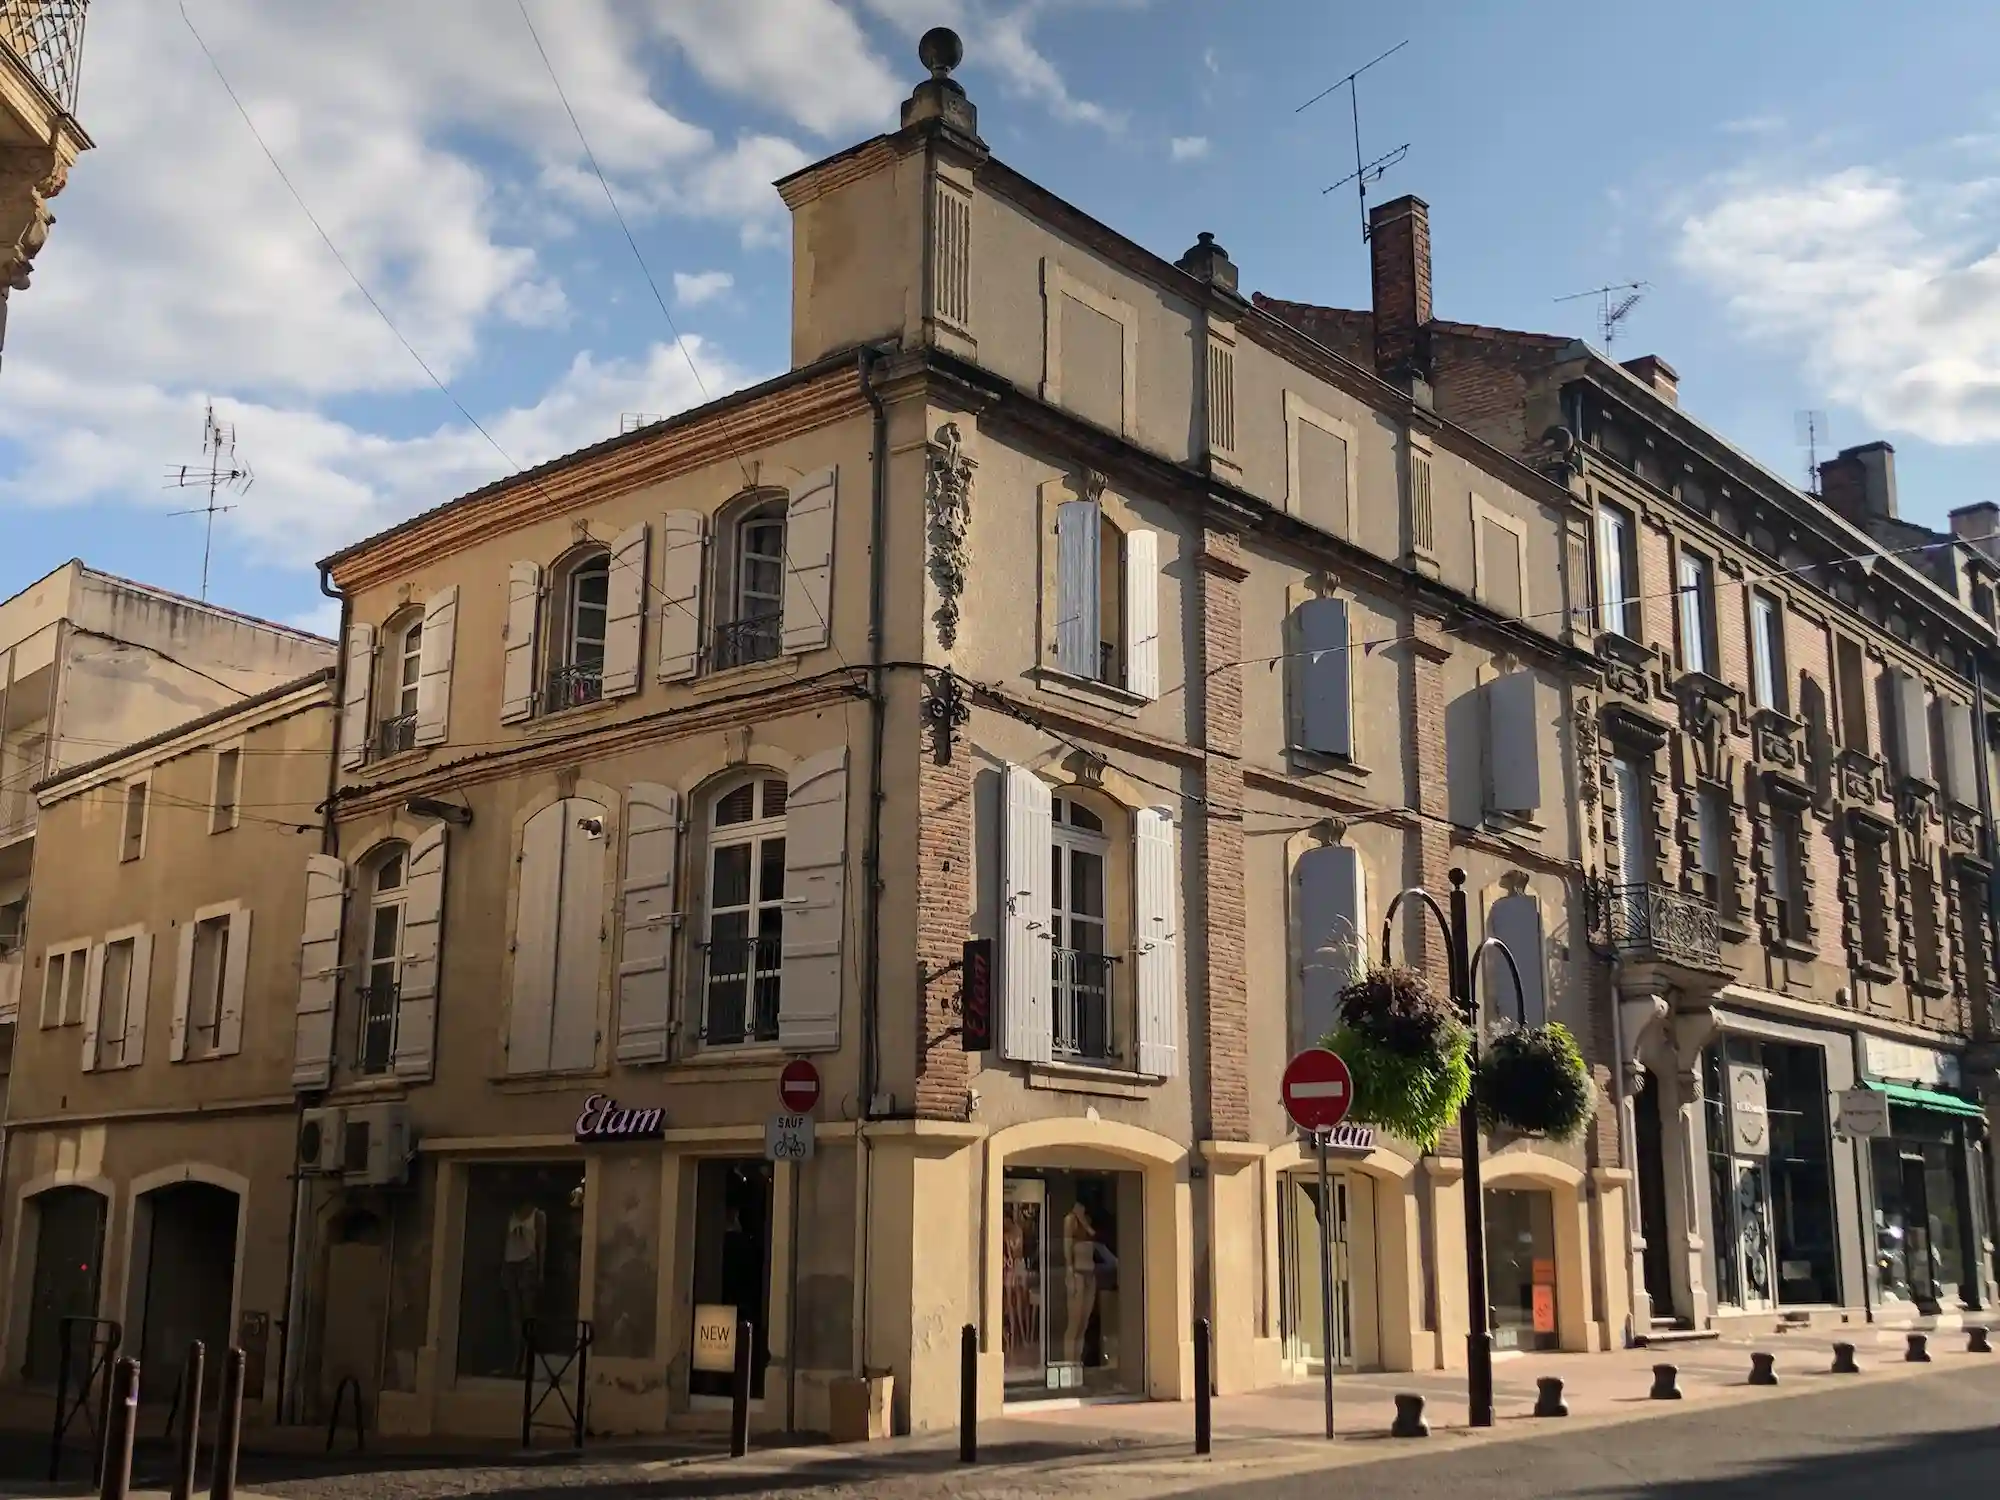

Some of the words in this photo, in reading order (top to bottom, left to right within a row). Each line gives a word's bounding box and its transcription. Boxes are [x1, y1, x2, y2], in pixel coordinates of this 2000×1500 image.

[575, 1093, 662, 1135] Etam
[778, 1117, 805, 1129] SAUF
[700, 1326, 730, 1341] NEW
